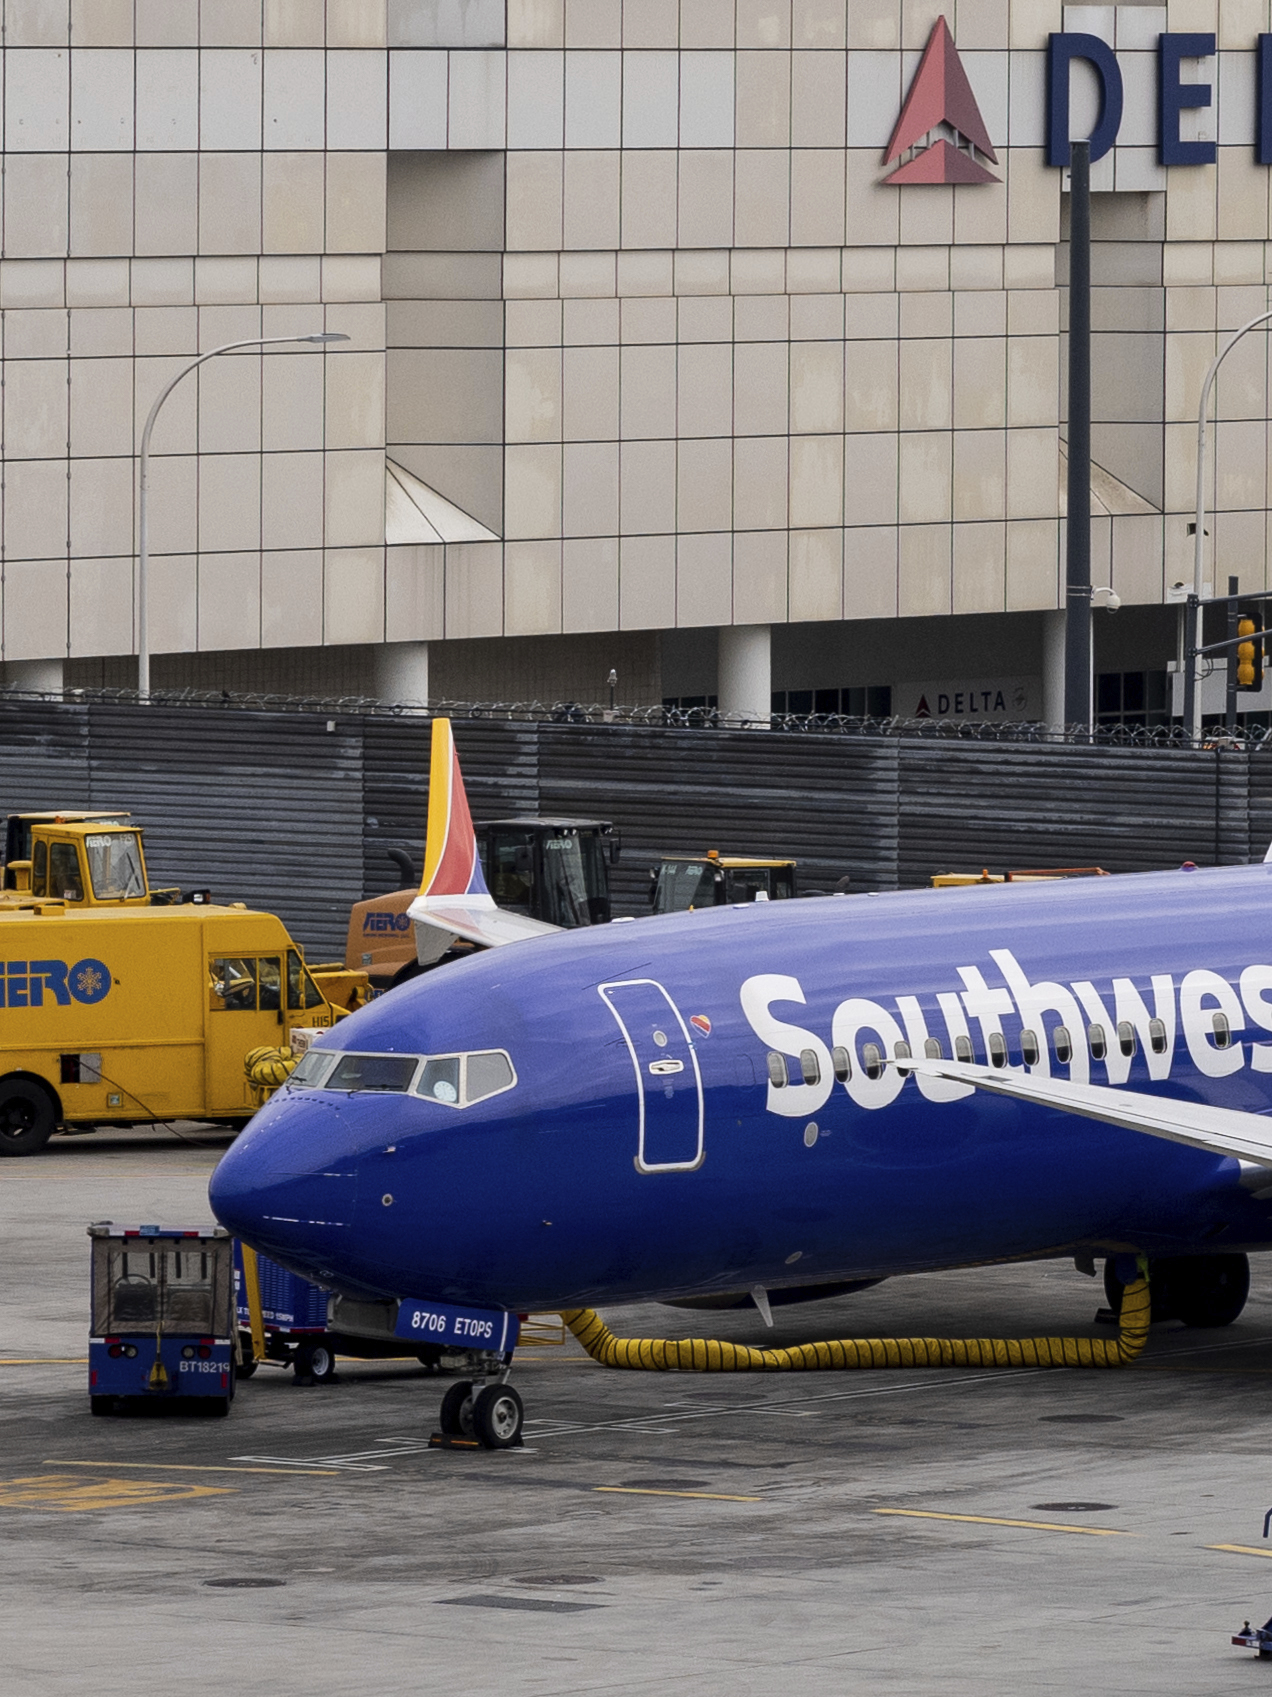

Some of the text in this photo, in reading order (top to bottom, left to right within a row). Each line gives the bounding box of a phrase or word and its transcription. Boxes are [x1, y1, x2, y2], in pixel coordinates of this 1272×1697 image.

[938, 690, 1006, 714] DELTA
[546, 839, 572, 850] AERO
[363, 911, 411, 932] AERO
[0, 957, 112, 1008] ERO
[312, 1015, 330, 1028] H15
[411, 1311, 493, 1338] 8706 ETOPS
[180, 1361, 231, 1373] BT18219
